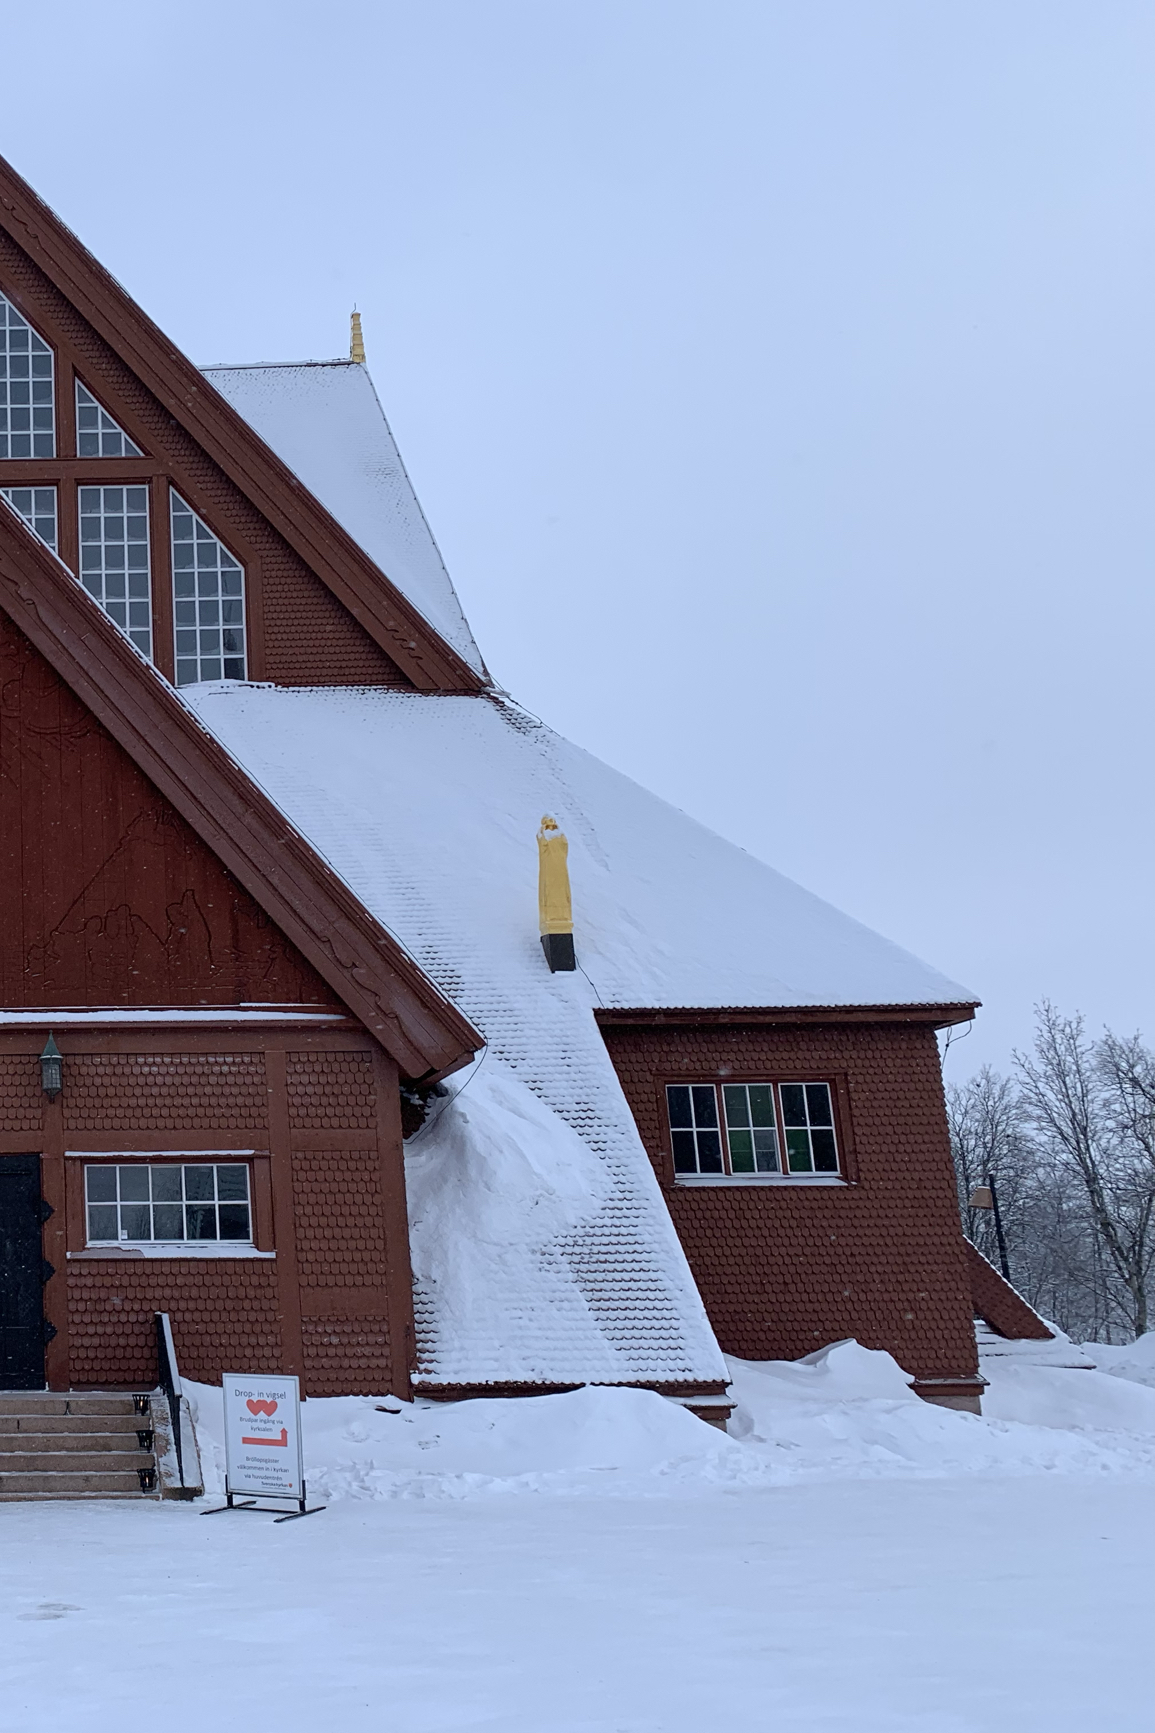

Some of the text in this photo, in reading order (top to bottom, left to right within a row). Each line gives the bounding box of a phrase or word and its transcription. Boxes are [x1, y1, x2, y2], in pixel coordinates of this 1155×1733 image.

[235, 1389, 286, 1400] Drop- in vigsel
